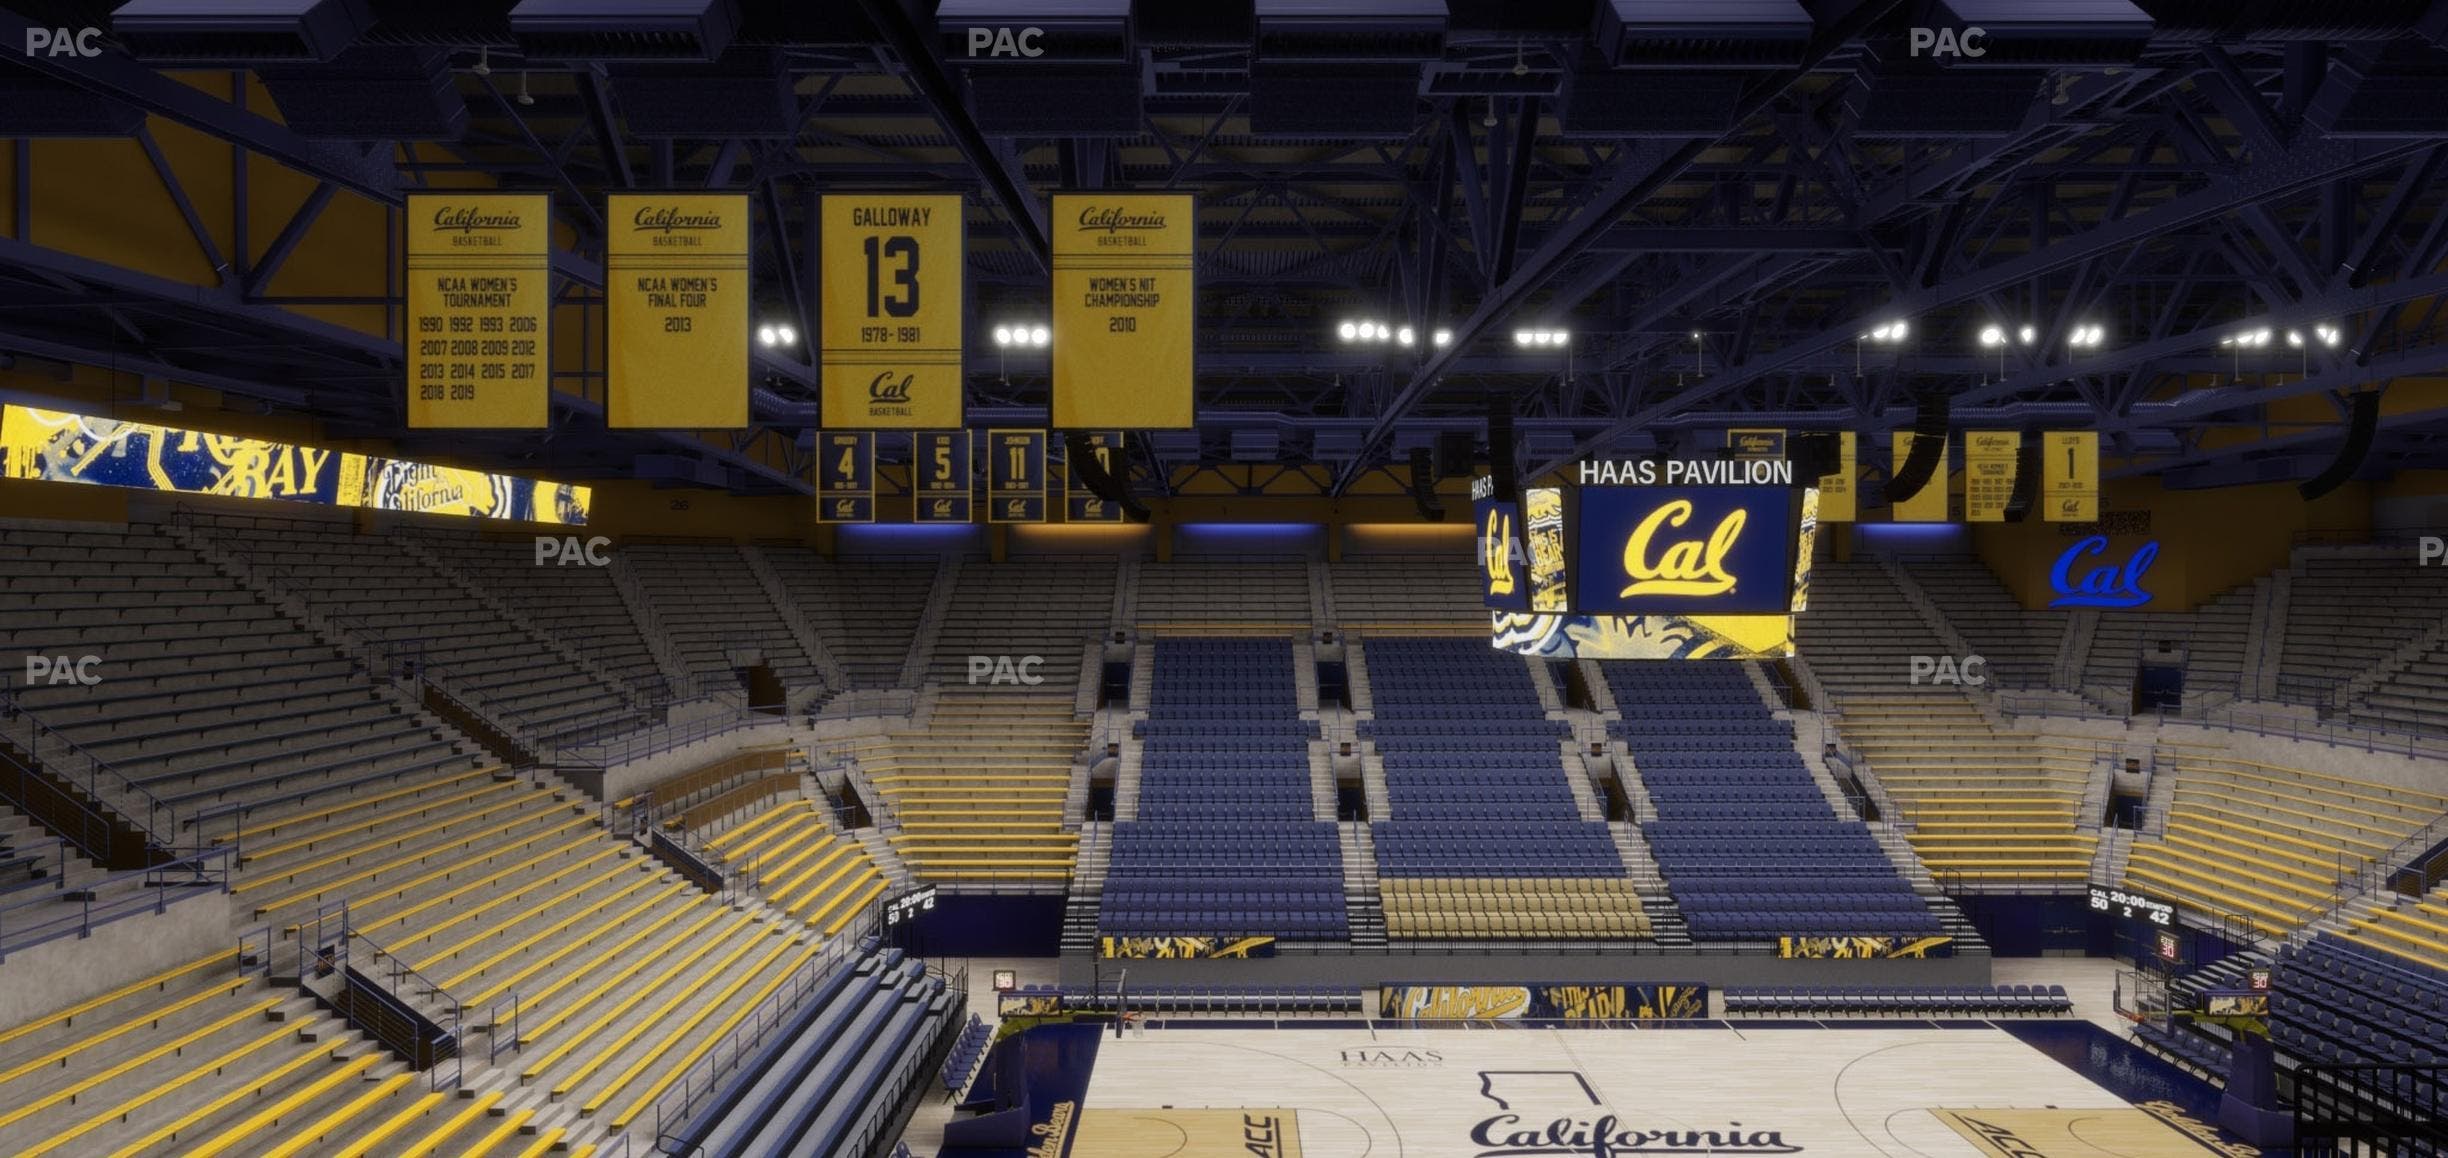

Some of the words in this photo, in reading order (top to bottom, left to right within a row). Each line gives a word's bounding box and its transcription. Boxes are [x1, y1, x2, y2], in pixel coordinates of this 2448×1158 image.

[433, 206, 522, 233] California
[634, 206, 722, 233] California
[853, 207, 931, 227] GALLOWAY
[1078, 206, 1167, 234] California
[437, 277, 467, 292] NCAA
[470, 277, 518, 292] WOMEN'S
[637, 277, 667, 292] NCAA
[670, 277, 718, 292] WOMEN'S
[864, 236, 920, 318] 13
[1089, 277, 1137, 292] WOMEN'S
[1139, 277, 1156, 292] NIT
[443, 294, 512, 308] TOURNAMENT
[648, 294, 677, 308] FINAL
[680, 294, 707, 308] FOUR
[1084, 293, 1160, 308] CHAMPIONSHIP
[419, 317, 443, 332] 1990
[450, 317, 473, 332] 1992
[480, 317, 504, 332] 1993
[509, 317, 537, 332] 2006
[665, 317, 692, 332] 2013
[1109, 317, 1136, 332] 2010
[420, 340, 447, 356] 2007
[451, 340, 478, 356] 2008
[480, 340, 508, 356] 2009
[511, 340, 535, 356] 2012
[420, 364, 444, 379] 2013
[450, 364, 475, 379] 2014
[481, 364, 505, 379] 2015
[511, 364, 535, 379] 2017
[420, 385, 445, 400] 2018
[450, 385, 475, 400] 2019
[869, 371, 914, 404] Cal
[837, 447, 854, 480] 4
[935, 447, 950, 480] 5
[1009, 447, 1025, 480] 11
[1580, 460, 1656, 485] HAAS
[1666, 460, 1792, 485] PAVILION
[2068, 447, 2075, 479] 1
[1472, 476, 1487, 501] HAAS
[1620, 500, 1748, 599] Cal
[2048, 535, 2160, 608] Cal
[2090, 889, 2109, 899] CAL
[2110, 891, 2146, 908] 20:00
[2090, 897, 2109, 910] 50
[2123, 907, 2132, 918] 2
[2149, 911, 2170, 925] 42
[2160, 943, 2174, 958] 30
[2253, 977, 2267, 989] 30
[1340, 1051, 1443, 1062] HAAS
[1470, 1114, 1804, 1158] California
